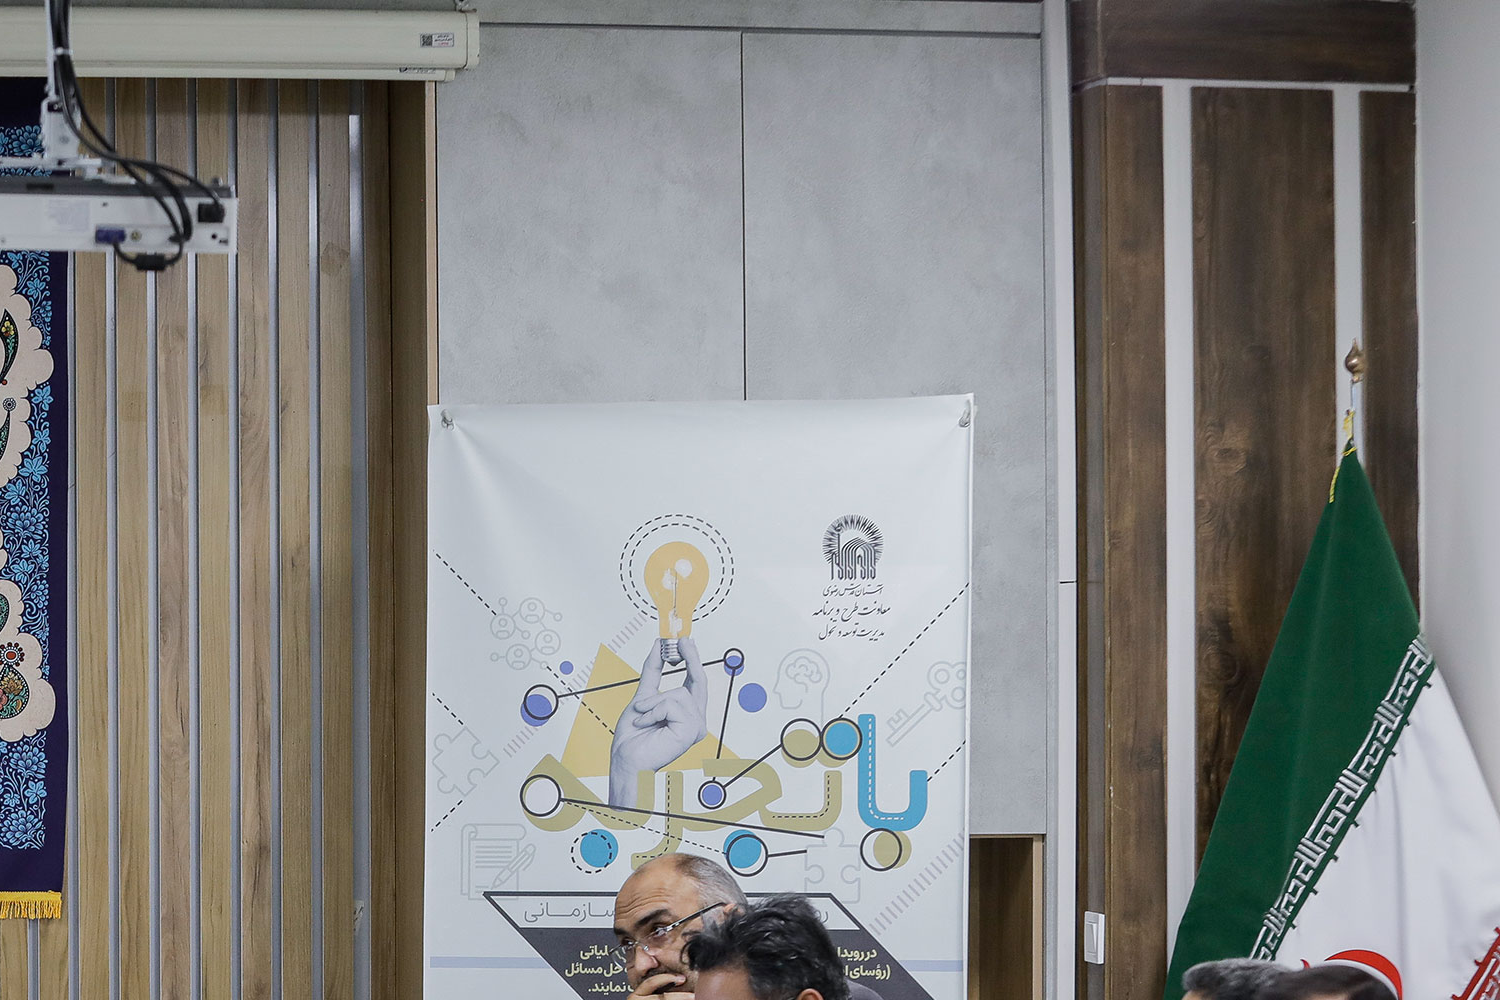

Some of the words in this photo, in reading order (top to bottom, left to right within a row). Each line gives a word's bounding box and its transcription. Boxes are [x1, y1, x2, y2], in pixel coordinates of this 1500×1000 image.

[812, 600, 837, 622] برنامه
[841, 601, 859, 622] طرح
[858, 600, 891, 616] معاونت
[856, 627, 885, 641] مدیریت
[837, 946, 864, 961] رویدا
[565, 962, 603, 977] مسائل
